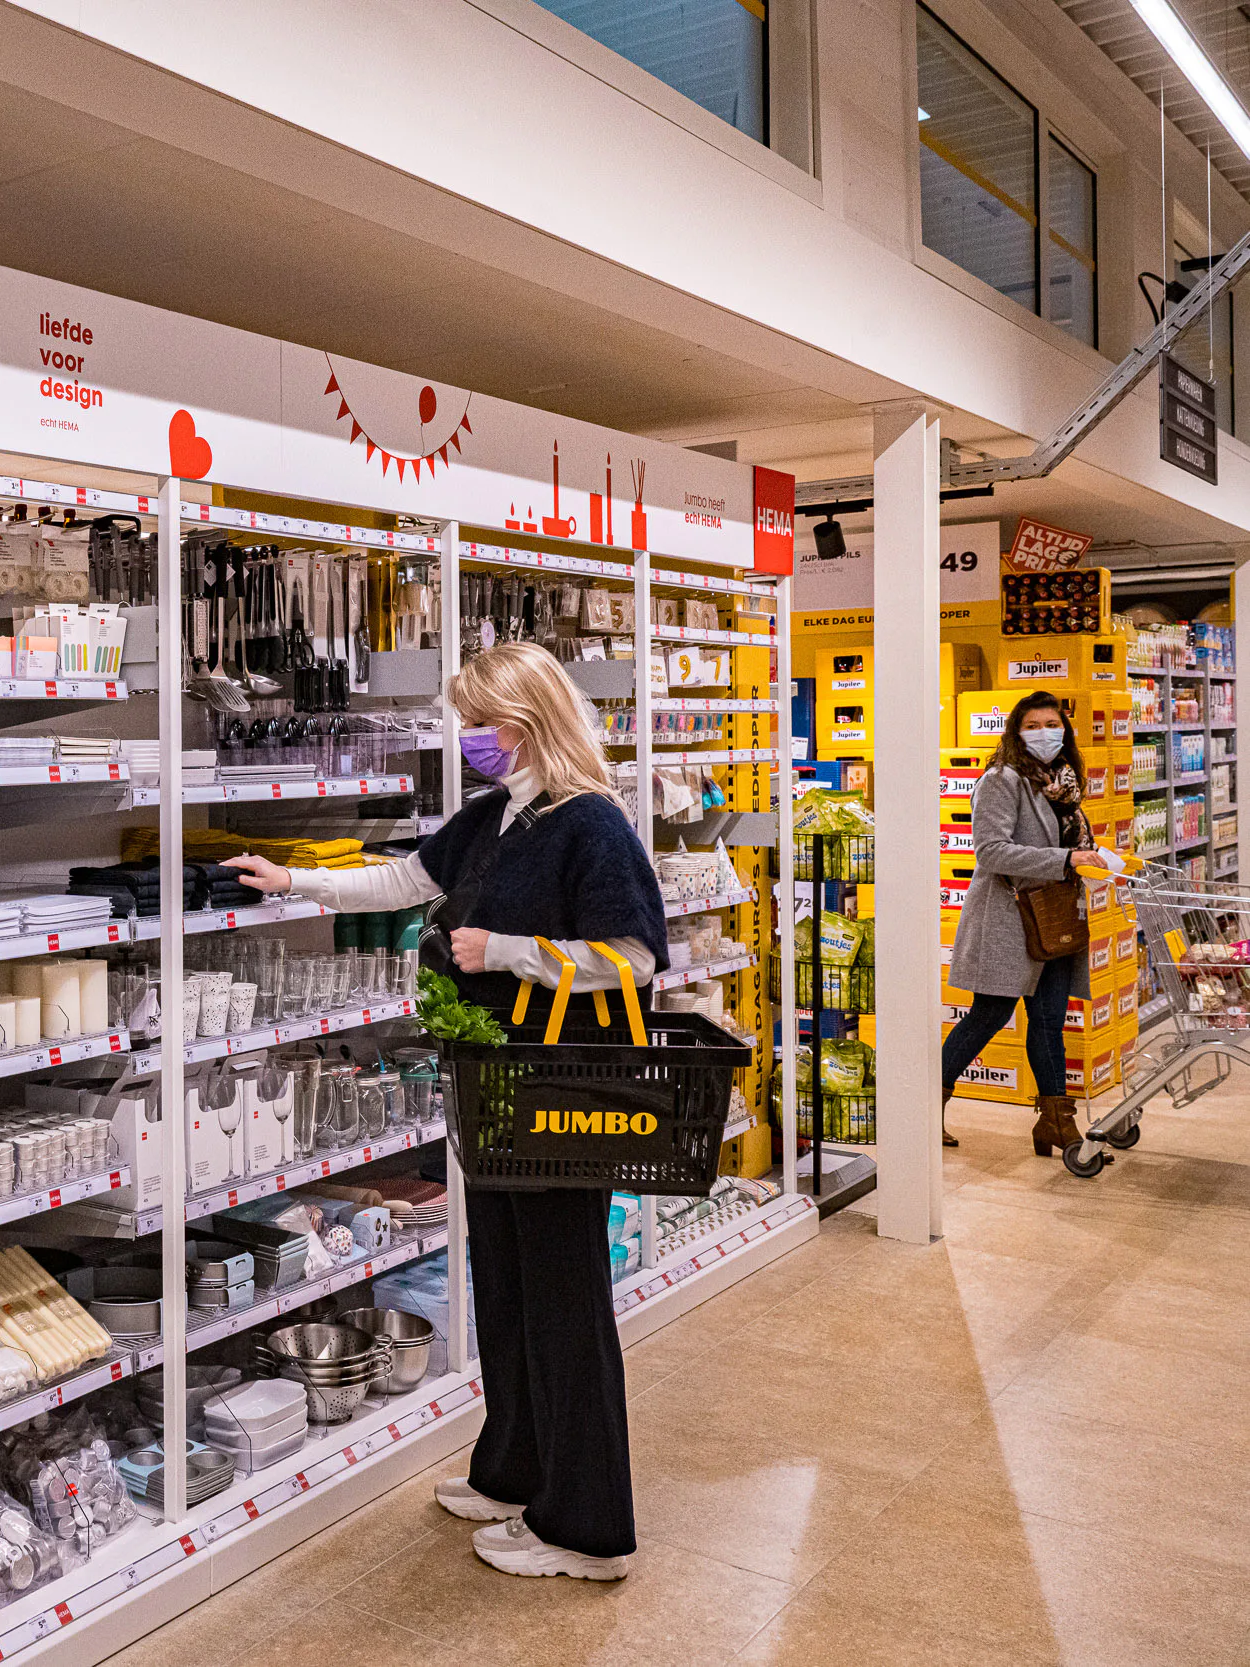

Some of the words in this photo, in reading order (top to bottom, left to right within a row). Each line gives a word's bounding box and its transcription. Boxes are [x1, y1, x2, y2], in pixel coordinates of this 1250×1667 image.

[39, 312, 93, 345] liefde
[39, 348, 85, 373] voor
[40, 377, 103, 409] design
[40, 418, 57, 428] echt
[58, 420, 80, 432] HEMA
[684, 491, 707, 508] Jumbo
[708, 496, 726, 512] heeft
[684, 511, 701, 525] echt
[701, 515, 722, 530] HEMA
[757, 506, 793, 537] HEMA
[1022, 525, 1084, 551] ALTIJD
[804, 618, 829, 627] ELKE
[832, 616, 855, 625] DAG
[1015, 662, 1062, 676] Jupiler
[836, 680, 861, 689] Jupiler
[977, 716, 1006, 730] Jupil
[836, 732, 861, 740] Jupiler
[820, 936, 852, 951] zoutjes
[752, 972, 762, 1031] DAG
[529, 1110, 658, 1136] JUMBO
